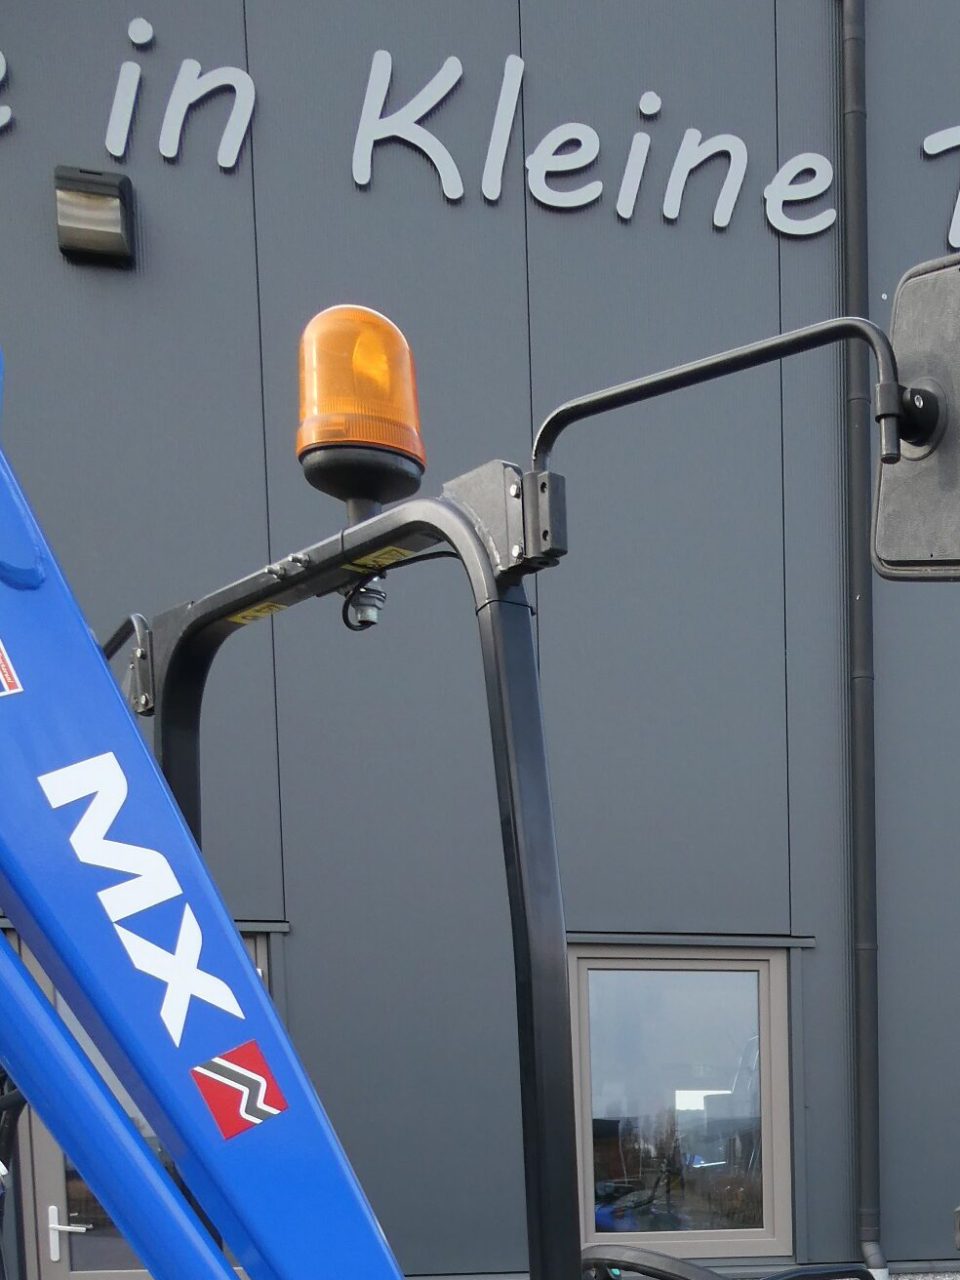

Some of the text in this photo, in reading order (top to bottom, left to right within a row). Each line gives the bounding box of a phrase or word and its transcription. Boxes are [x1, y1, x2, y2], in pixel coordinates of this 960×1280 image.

[105, 17, 255, 170] in
[352, 49, 838, 236] Kleine
[37, 751, 246, 1048] MX
